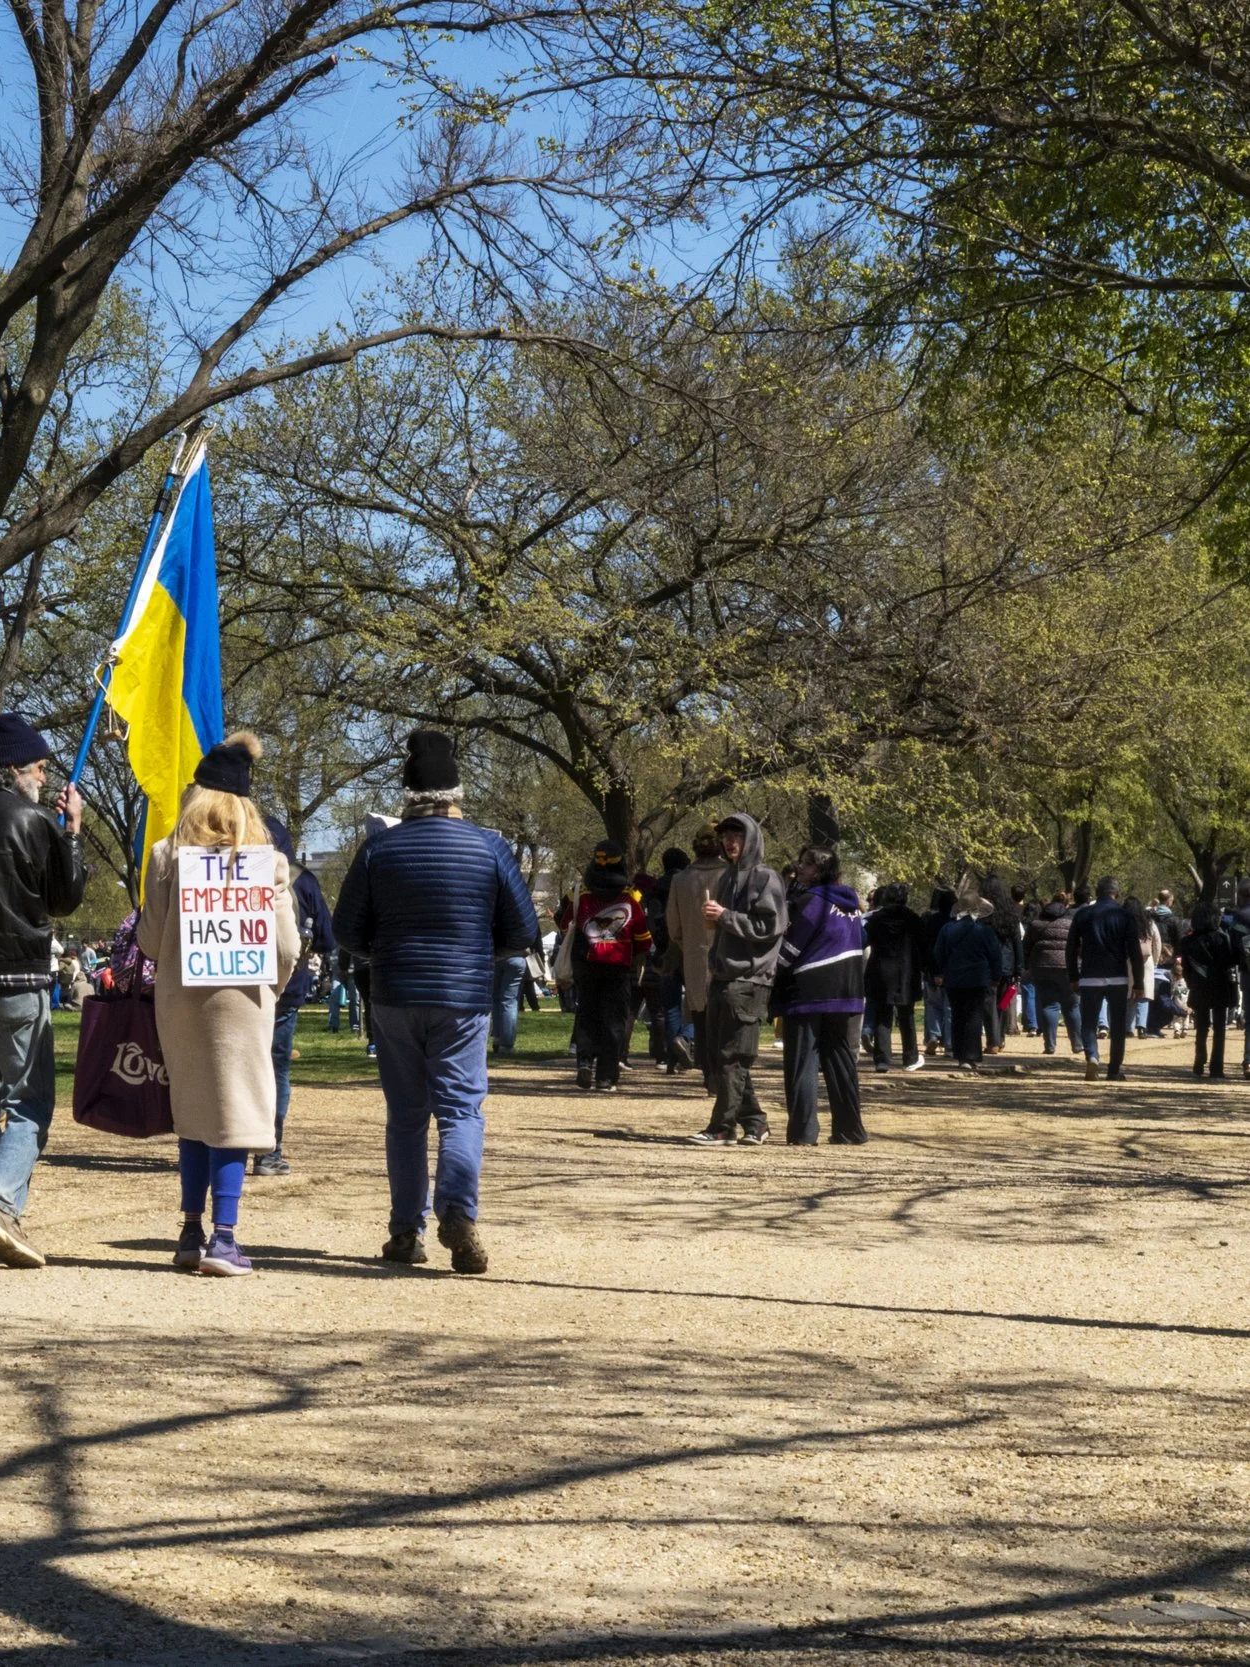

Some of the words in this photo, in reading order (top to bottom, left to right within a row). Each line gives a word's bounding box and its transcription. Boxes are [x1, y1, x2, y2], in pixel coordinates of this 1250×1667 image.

[200, 855, 249, 881] THE
[181, 886, 275, 913] EMPEROR
[189, 919, 233, 944] HAS
[240, 919, 268, 945] NO
[188, 950, 265, 976] CLUES!
